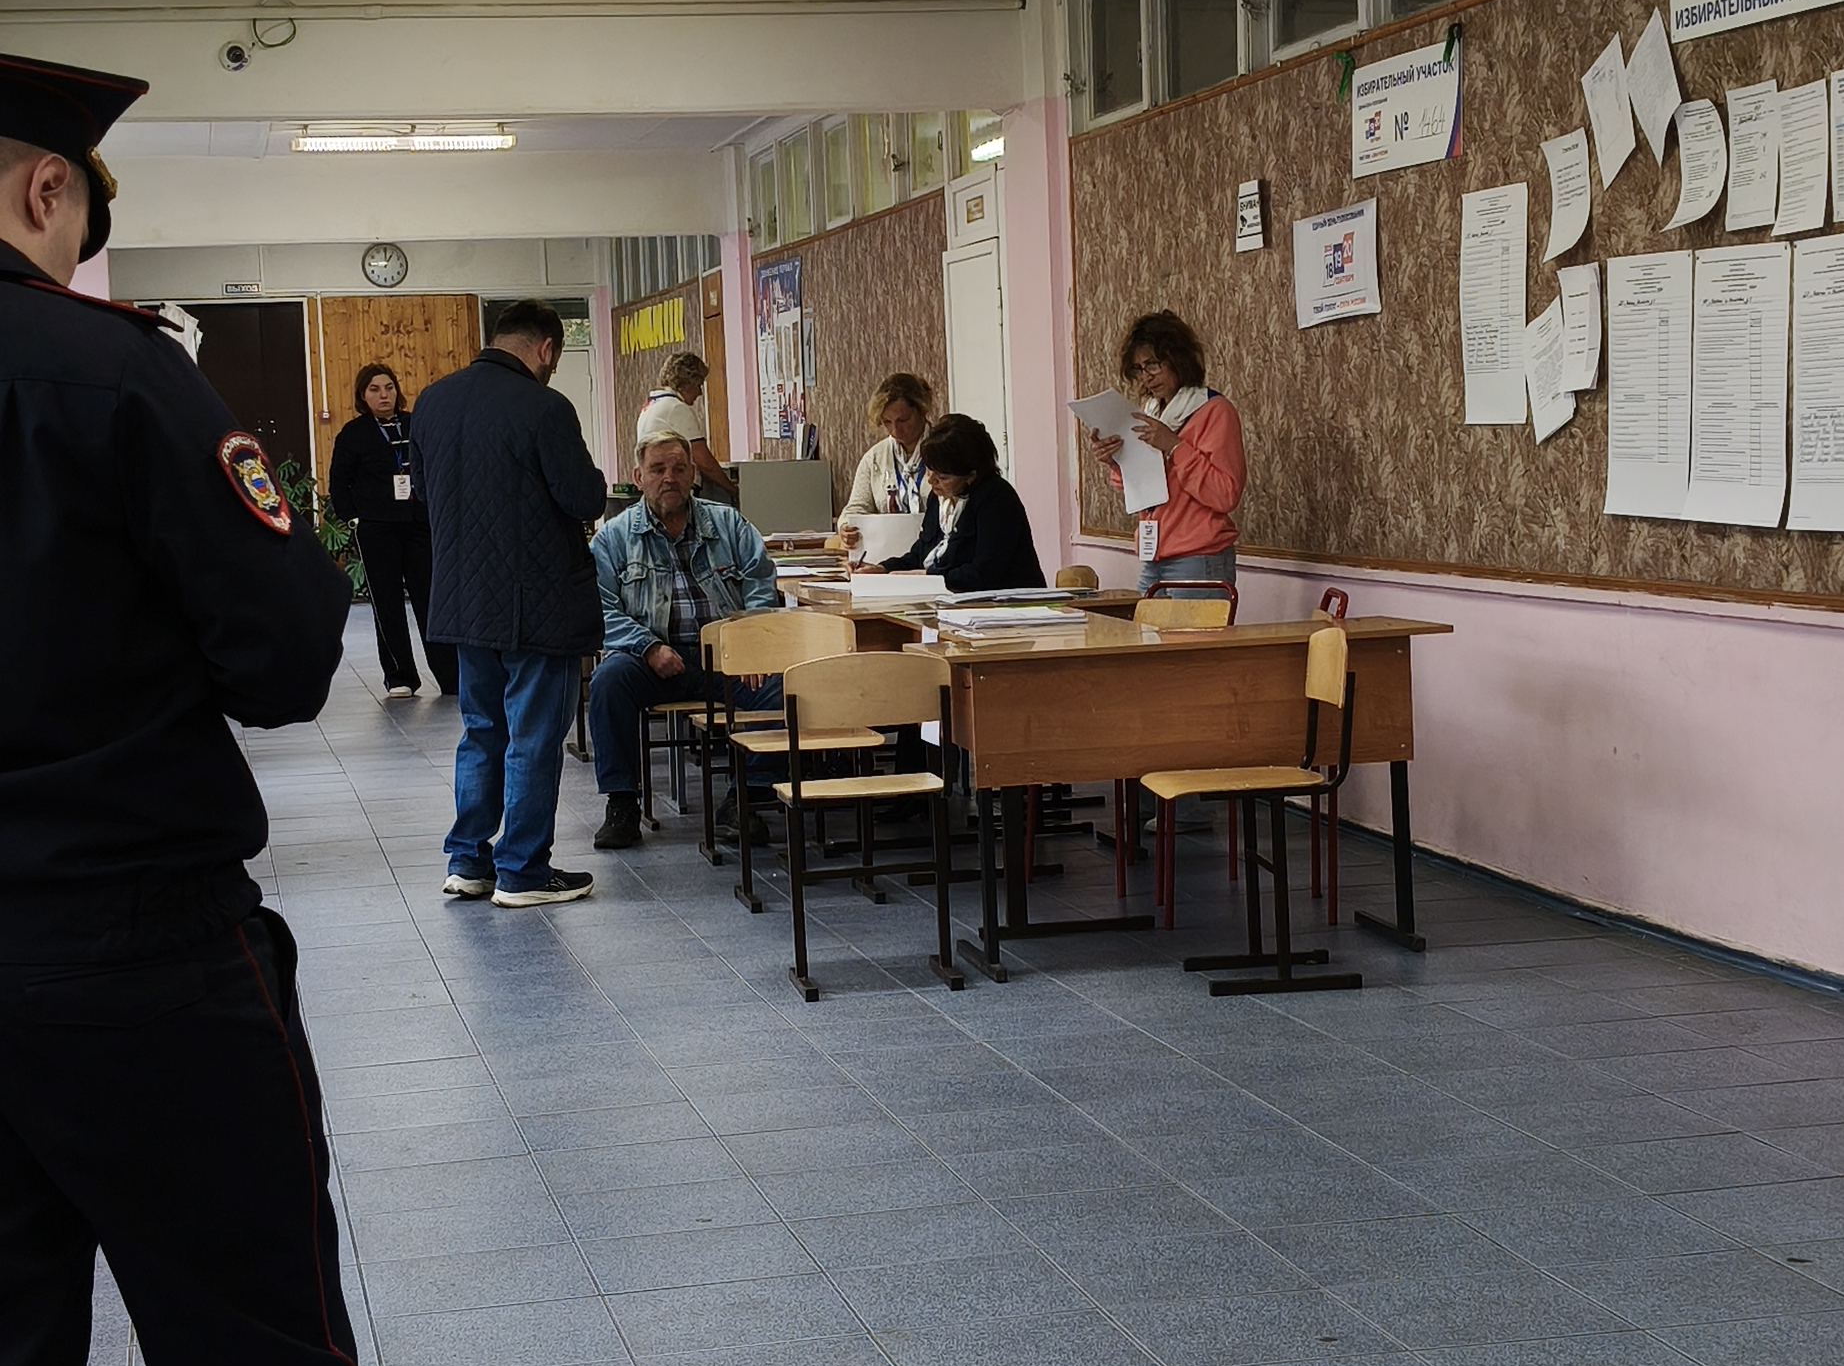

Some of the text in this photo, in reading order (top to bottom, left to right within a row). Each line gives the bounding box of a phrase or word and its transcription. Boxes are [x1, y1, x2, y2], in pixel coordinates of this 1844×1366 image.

[1356, 64, 1415, 98] ИЗБИРАТЕЛЬНЫЙ
[1394, 112, 1409, 142] №
[1342, 239, 1353, 259] 20
[1333, 250, 1343, 269] 19
[1325, 262, 1334, 280] 18
